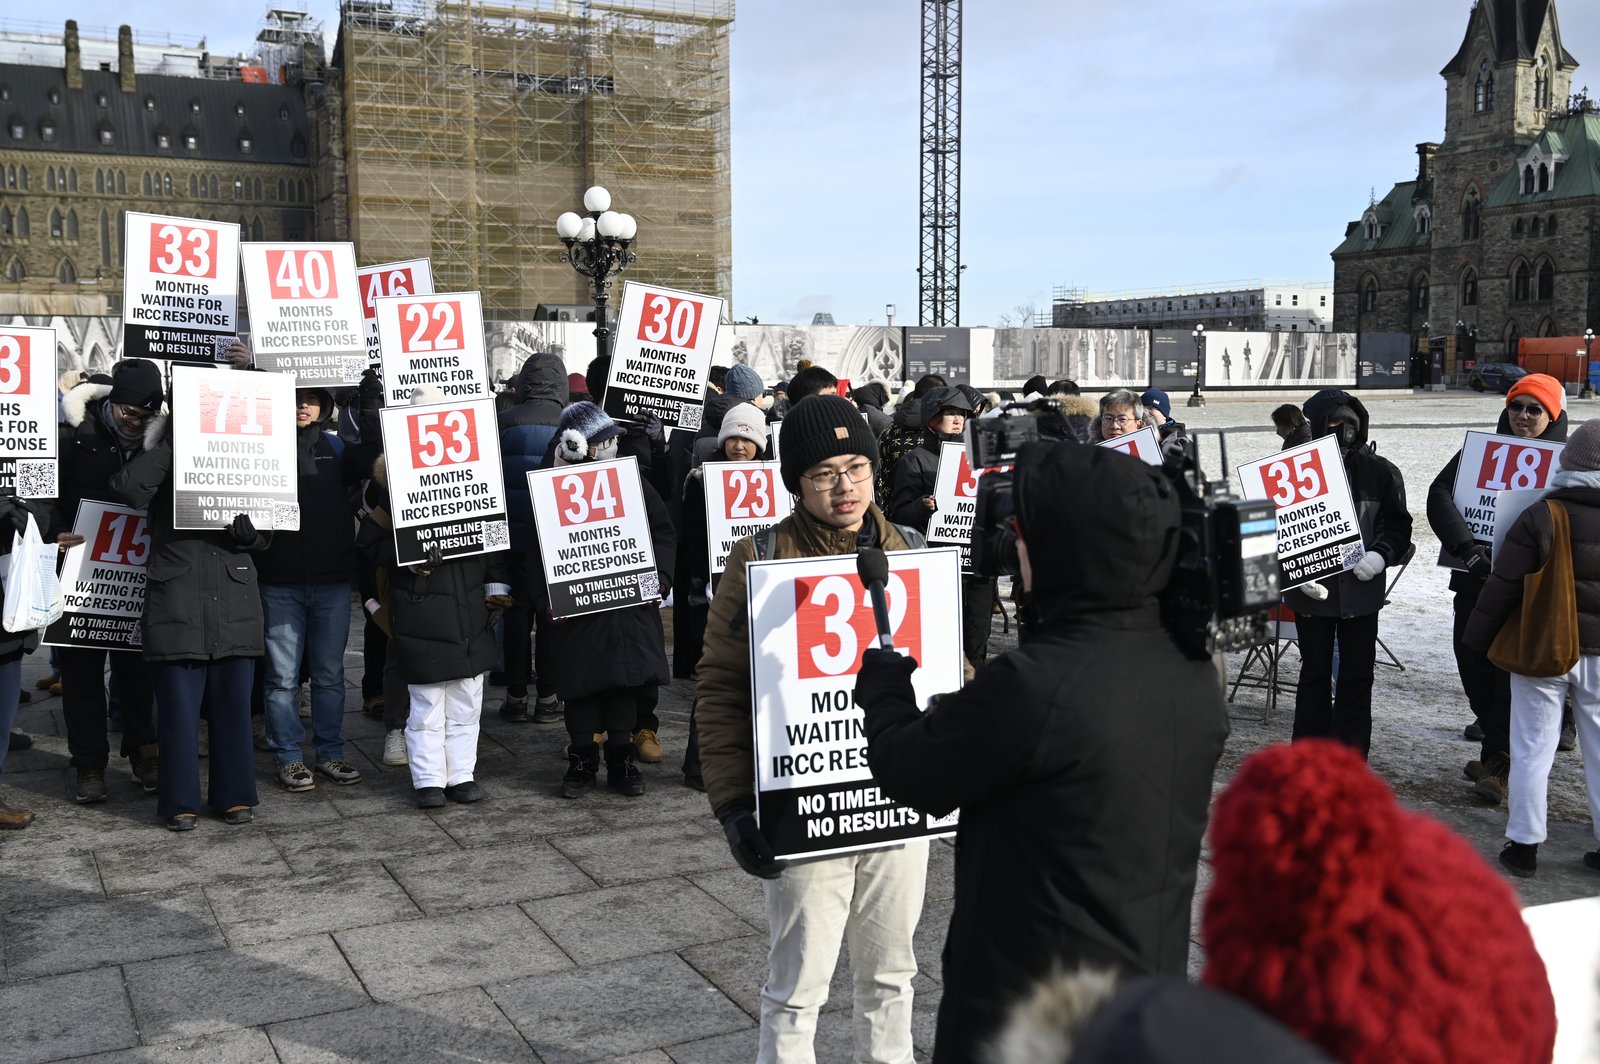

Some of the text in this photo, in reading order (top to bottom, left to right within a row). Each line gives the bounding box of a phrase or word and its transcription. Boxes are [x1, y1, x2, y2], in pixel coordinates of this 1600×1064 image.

[157, 225, 210, 276] 33
[276, 250, 330, 298] 40
[156, 280, 209, 295] MONTHS
[367, 271, 409, 308] 46
[141, 293, 222, 311] WAITING FOR
[133, 308, 229, 326] IRCC RESPONSE
[279, 306, 333, 317] MONTHS
[267, 320, 348, 332] WAITING FOR
[406, 303, 457, 351] 22
[645, 296, 695, 346] 30
[145, 330, 215, 344] NO TIMELINES
[262, 336, 292, 347] IRCC
[294, 334, 357, 347] RESPONSE
[149, 342, 211, 355] NO RESULTS
[640, 348, 686, 364] MONTHS
[277, 356, 342, 367] NO TIMELINE
[410, 356, 459, 370] MONTHS
[626, 359, 695, 380] WAITING FOR
[301, 368, 343, 379] RESULTS
[398, 370, 473, 385] WAITING FOR
[393, 383, 481, 400] IRC PONSE
[616, 372, 700, 394] IRCC RESPONSE
[209, 381, 263, 433] 71
[624, 393, 684, 410] NO TIMELINES
[626, 405, 678, 420] NO SULTS
[9, 421, 38, 433] FOR
[208, 440, 264, 454] MONTHS
[418, 411, 471, 466] 53
[193, 456, 280, 470] WAITING FOR
[1485, 445, 1541, 491] 18
[184, 472, 288, 487] IRCC RESPONSE
[420, 469, 473, 487] MONTHS
[1268, 452, 1320, 506] 35
[198, 496, 274, 508] NO TIMELINES
[408, 483, 488, 504] WAITING FOR
[561, 470, 617, 523] 34
[729, 470, 770, 518] 23
[204, 510, 219, 520] NO
[402, 497, 497, 521] IRCC RESPONSE
[1279, 502, 1326, 525] MONTHS
[1464, 507, 1495, 522] WAITI
[944, 515, 973, 525] WAITI
[1320, 511, 1341, 526] FOR
[100, 515, 150, 565] 15
[417, 529, 431, 540] NO
[569, 526, 621, 543] MONTHS
[935, 527, 958, 537] IRCC
[1278, 542, 1292, 554] CC
[1294, 522, 1351, 548] RESPONSE
[440, 535, 484, 550] RESULTS
[558, 538, 637, 560] WAITING FOR
[553, 551, 646, 577] IRCC RESPONSE
[1282, 560, 1296, 571] NO
[1289, 556, 1342, 580] NO RESULTS
[92, 568, 146, 583] MONTHS
[76, 581, 145, 598] WAITING FO
[569, 575, 637, 595] NO TIMELINES
[64, 595, 143, 612] RCC RESPON
[576, 588, 635, 606] NO RESULTS
[69, 617, 84, 627] NO
[87, 618, 135, 631] TIMELINE
[809, 571, 909, 675] 32
[71, 629, 132, 642] NO RESULTS
[786, 717, 867, 746] WAITIN
[773, 754, 824, 778] IRCC
[798, 787, 895, 815] NO TIMEL
[808, 807, 919, 838] NO RESULTS
